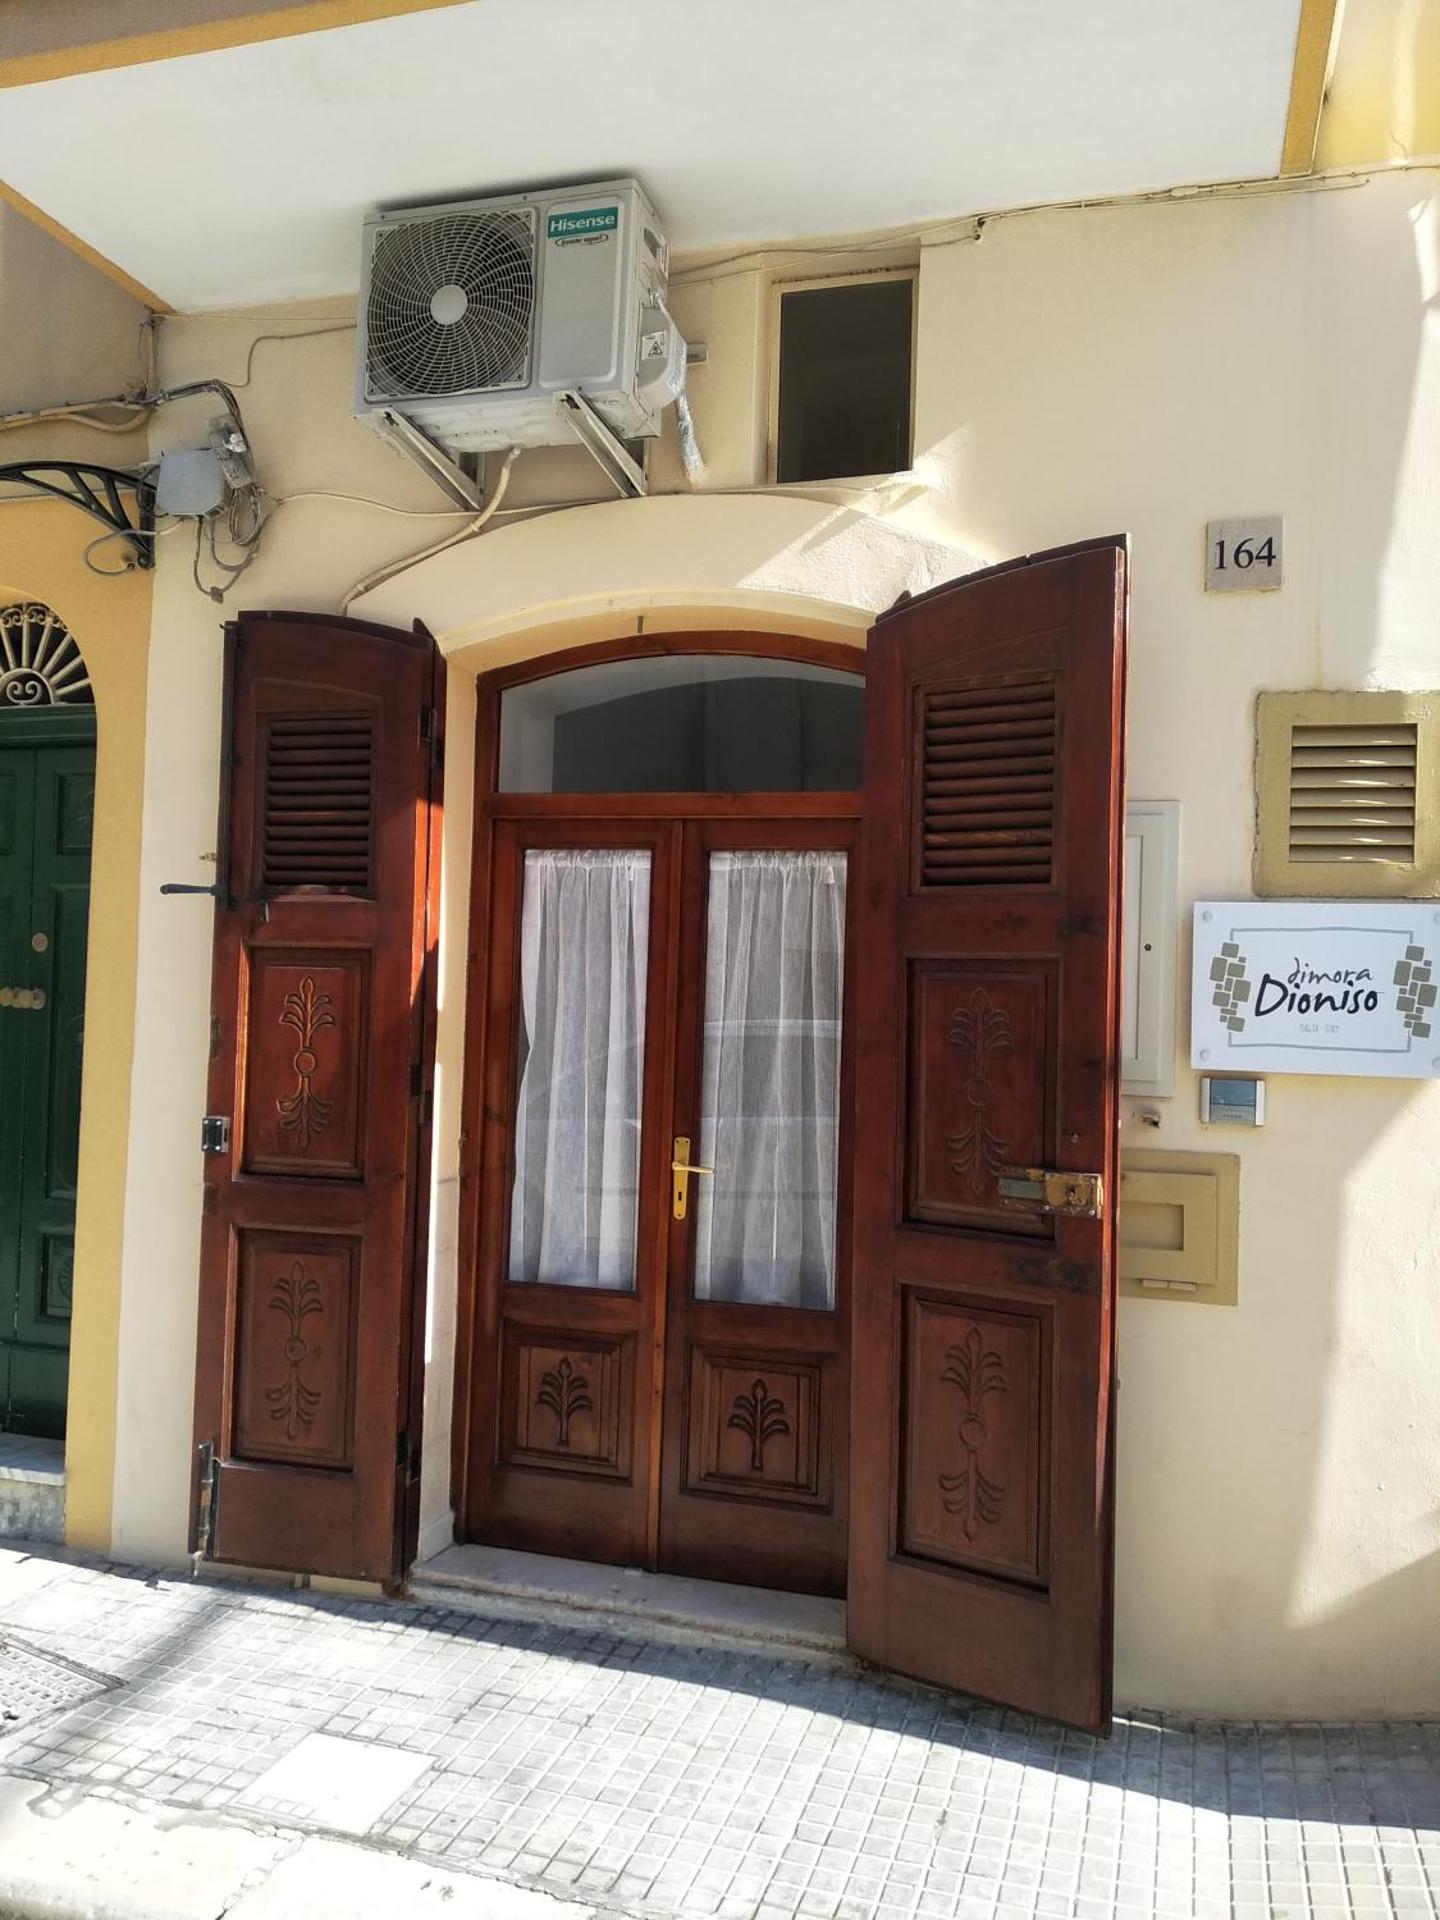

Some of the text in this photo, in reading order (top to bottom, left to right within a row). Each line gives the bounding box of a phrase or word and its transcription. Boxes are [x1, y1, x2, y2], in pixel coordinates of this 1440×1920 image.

[550, 215, 615, 232] Hisense
[1214, 537, 1277, 570] 164
[1287, 956, 1373, 985] dimora
[1255, 973, 1379, 1017] Dioniso
